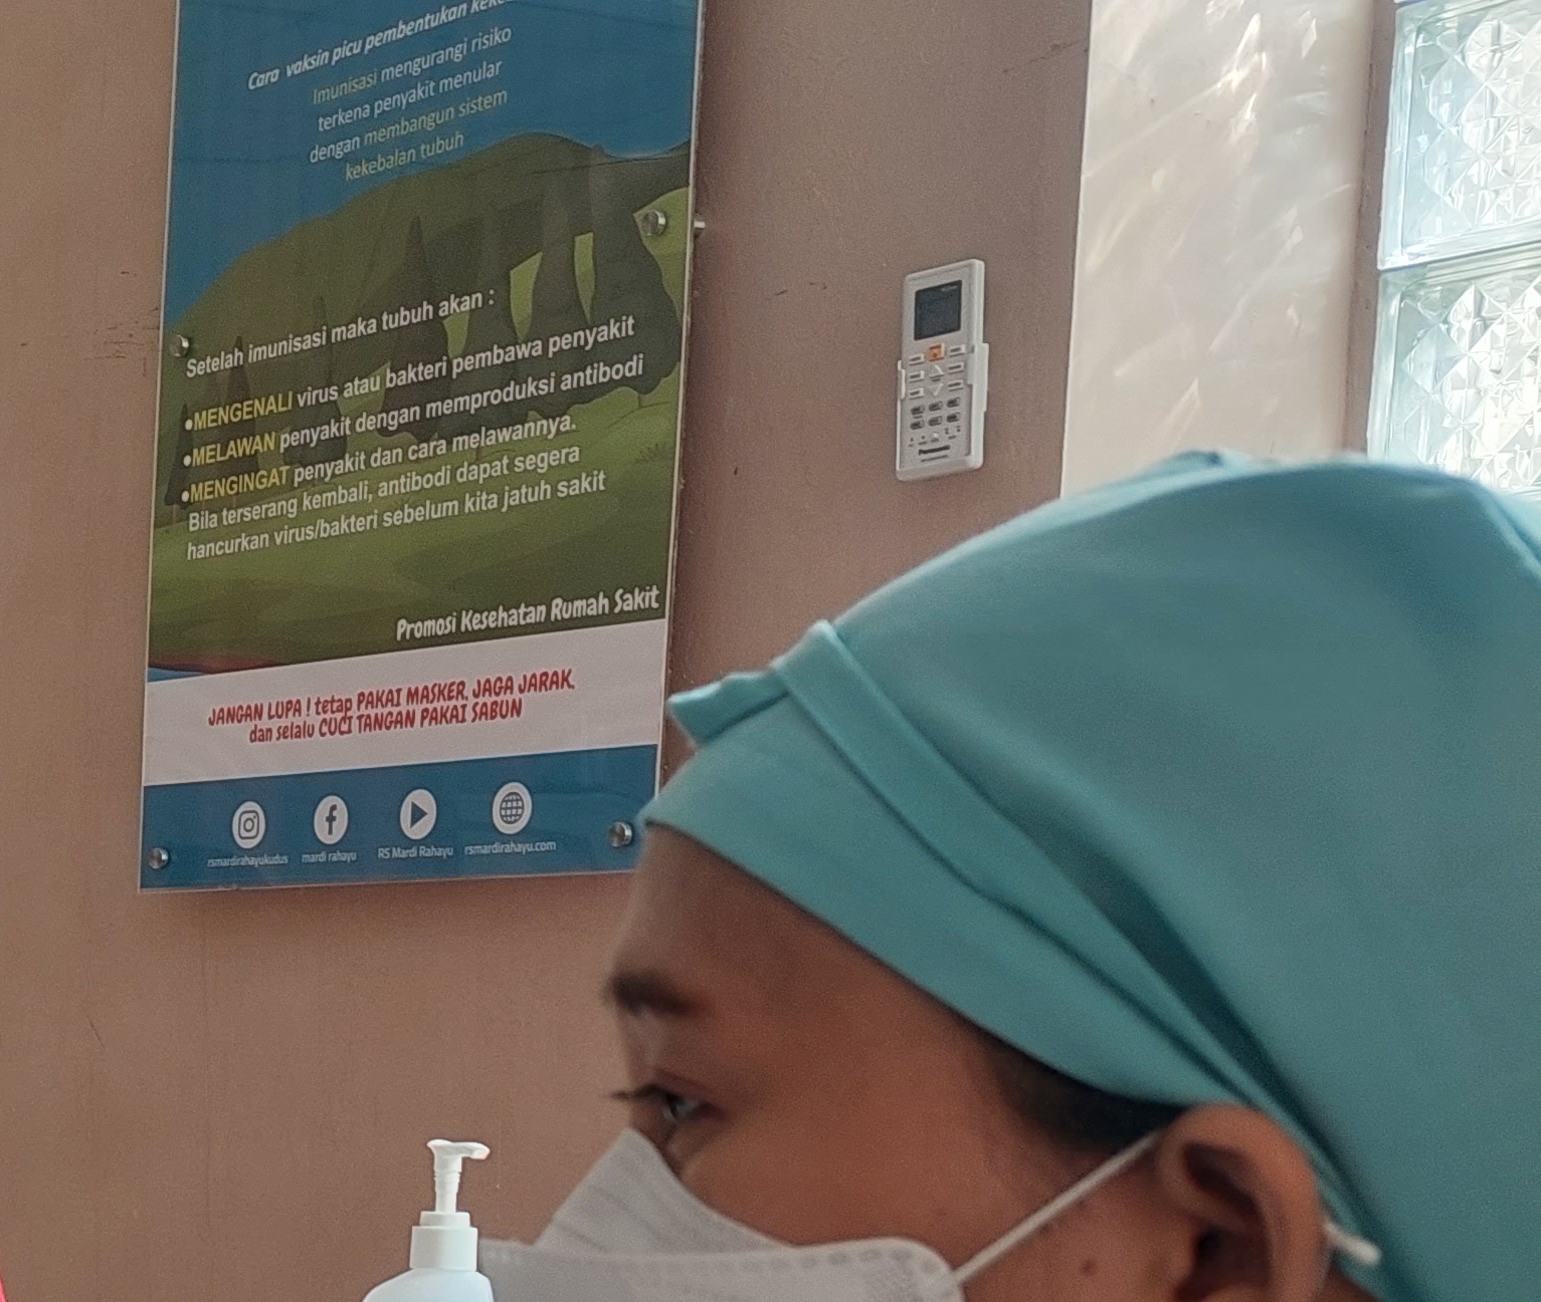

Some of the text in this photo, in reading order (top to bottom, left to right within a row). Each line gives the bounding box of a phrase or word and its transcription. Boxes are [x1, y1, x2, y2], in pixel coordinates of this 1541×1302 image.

[248, 68, 279, 90] Cara
[286, 49, 329, 78] vaksin
[331, 37, 363, 66] picu
[364, 2, 468, 55] pembentukan
[312, 26, 512, 104] Imunisasi mengurangi risiko
[309, 89, 508, 163] dengan membangun sistem
[318, 59, 503, 132] terkena penyakit menular
[345, 130, 465, 181] kekebalan tubuh
[186, 347, 244, 378] Setelah
[248, 325, 327, 363] imunisasi
[331, 316, 377, 343] maka
[382, 302, 433, 330] tubuh
[438, 292, 483, 317] akan
[193, 314, 636, 431] MENGENALI virus atau bakteri pembawa penyakit
[192, 353, 645, 467] MELAWAN penyakit dengan memproduksi antibodi
[188, 446, 581, 532] Bila terserang kembali, antibodi dapat segera
[190, 414, 577, 502] MENGINGAT penyakit dan cara melawannya.
[186, 470, 607, 560] hancurkan virus/bakteri sebelum kita jatuh sakit
[396, 585, 661, 641] Promosi Kesehatan Rumah Sakit
[208, 702, 264, 726] JANGAN
[267, 699, 302, 720] LUPA
[315, 695, 353, 718] tetap
[356, 687, 403, 711] PAKAI
[472, 675, 514, 699] JAGA
[249, 698, 523, 743] dan selalu CUCI TANGAN PAKAI SABUN
[301, 850, 357, 863] mardi rahayu
[377, 845, 454, 859] RS Mardi Rahayu
[464, 841, 557, 855] rsmardirahayu.com
